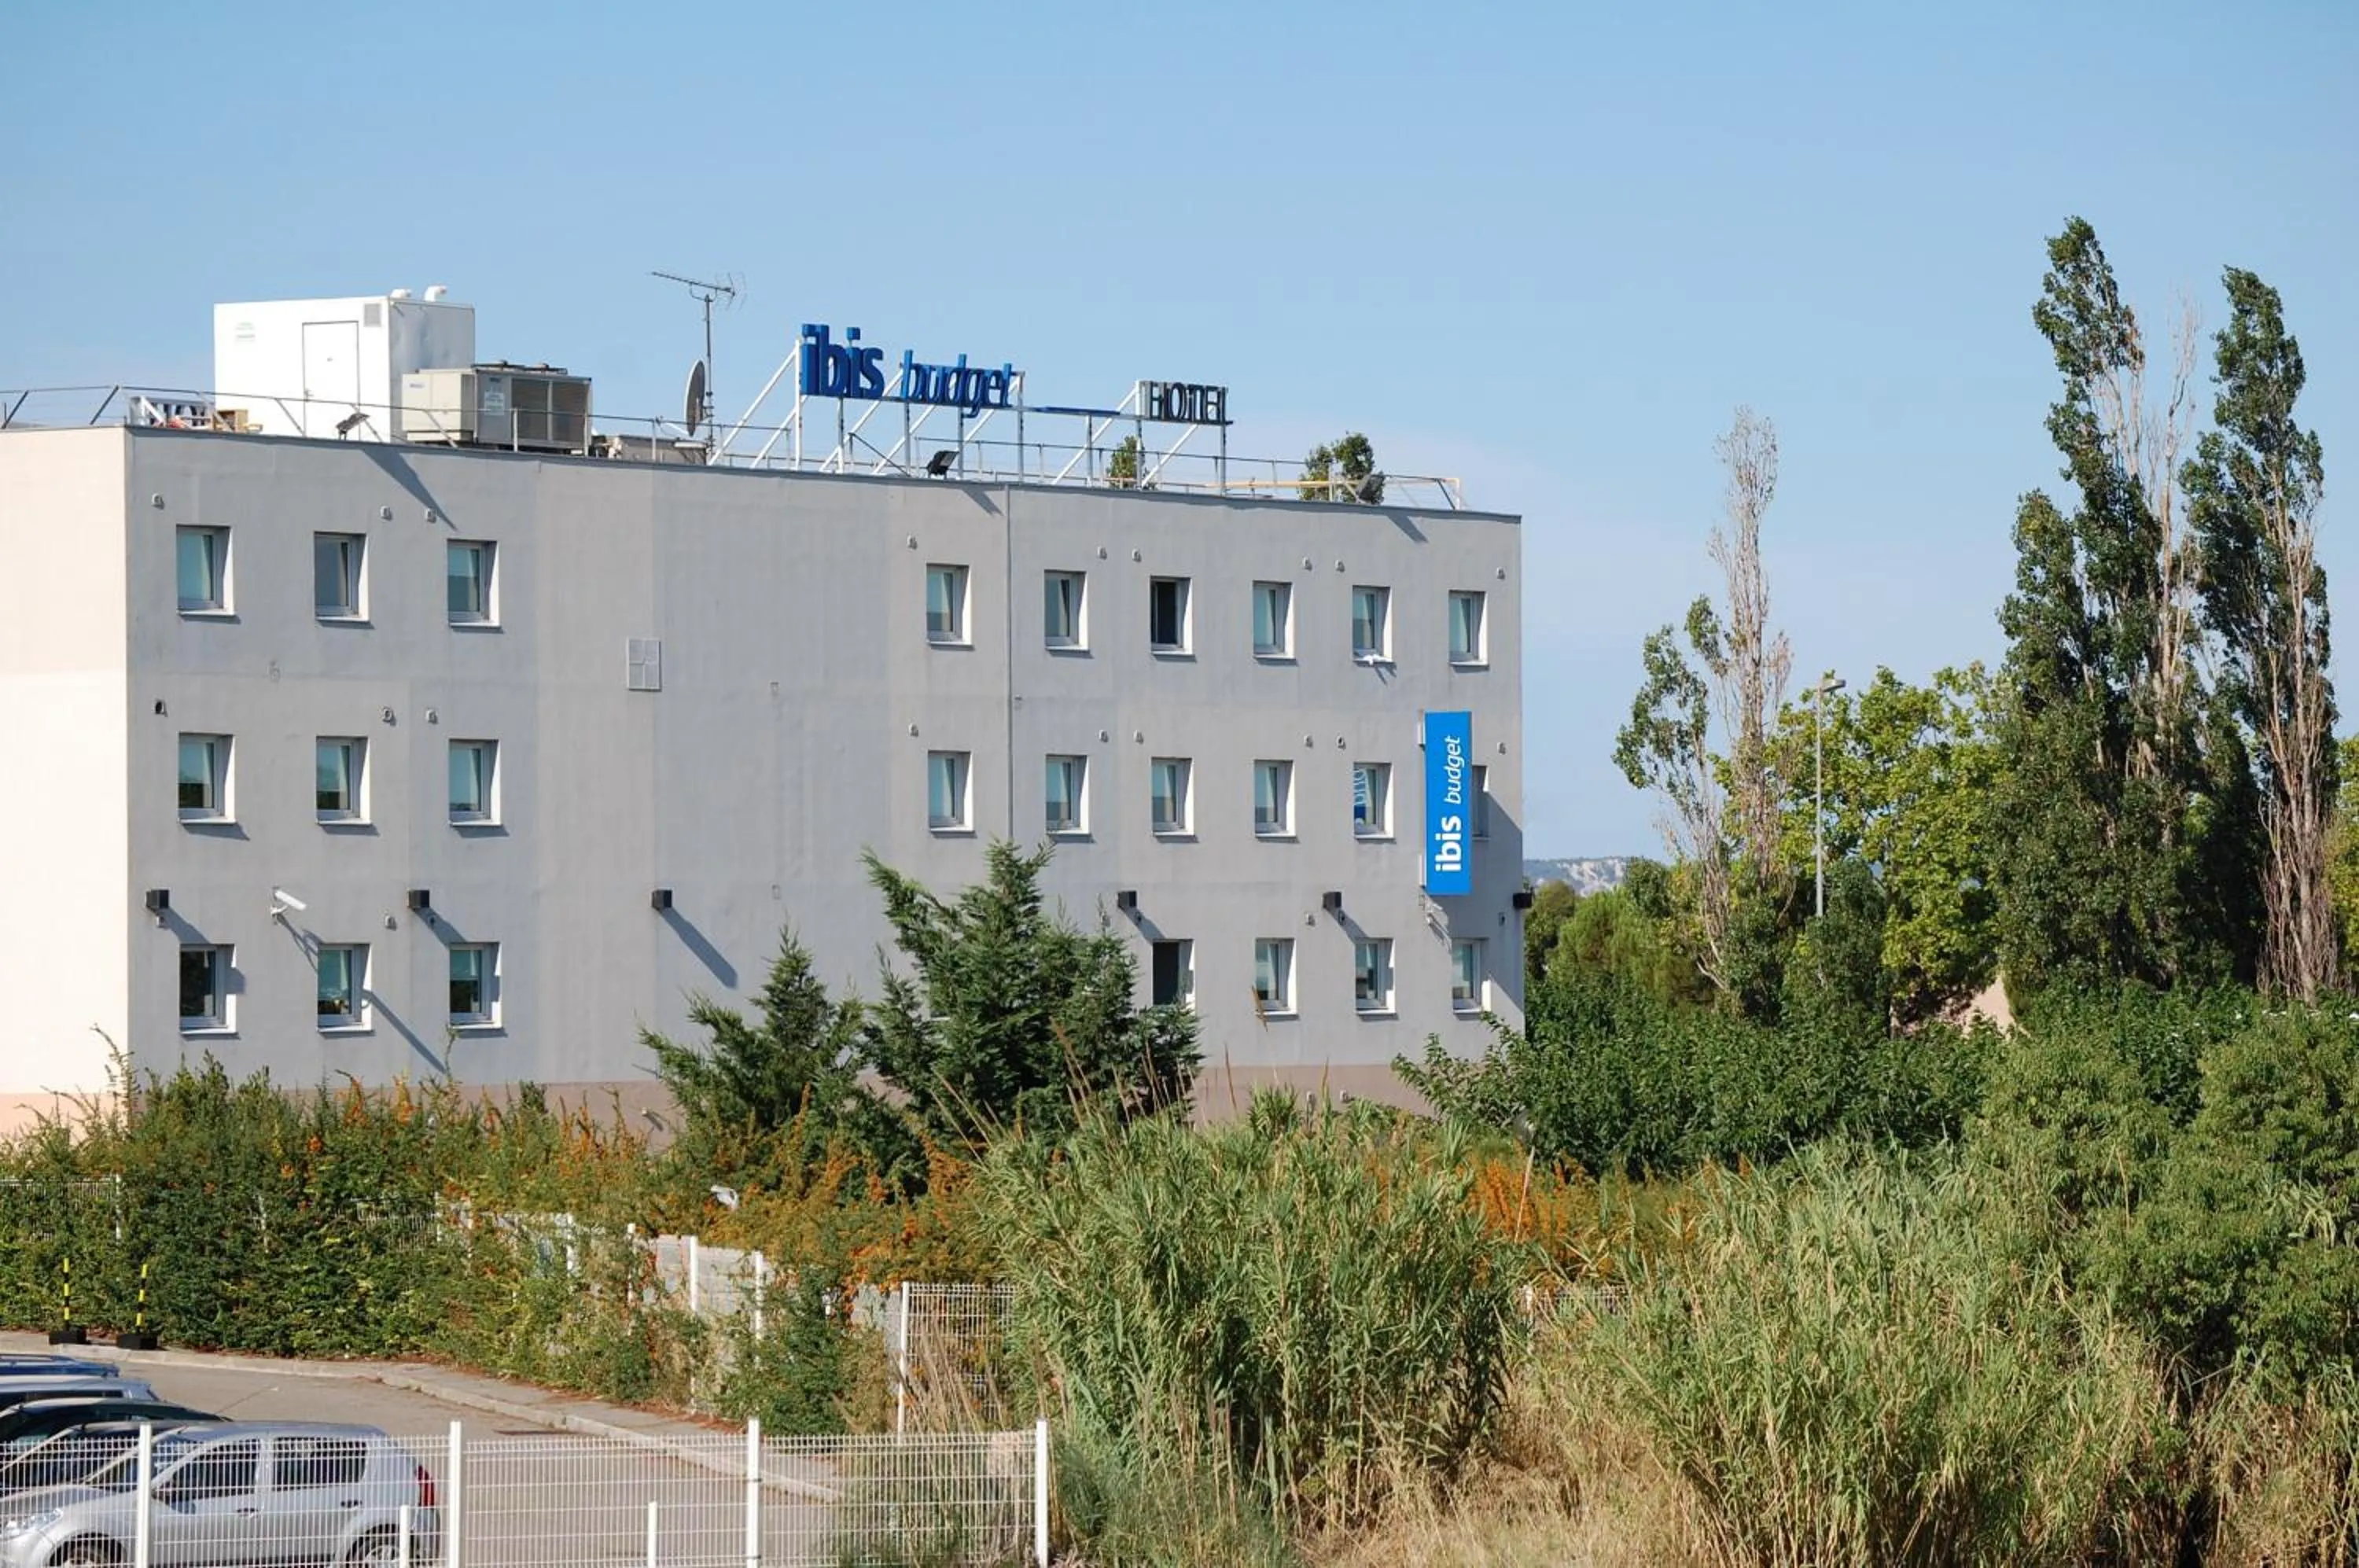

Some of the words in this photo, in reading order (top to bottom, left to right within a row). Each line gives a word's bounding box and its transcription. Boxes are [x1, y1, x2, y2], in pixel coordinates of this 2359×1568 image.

[801, 323, 885, 398] ibis
[900, 349, 1012, 418] budget
[1138, 381, 1228, 425] HOTEL
[1443, 735, 1465, 804] budget
[1435, 815, 1462, 871] ibis
